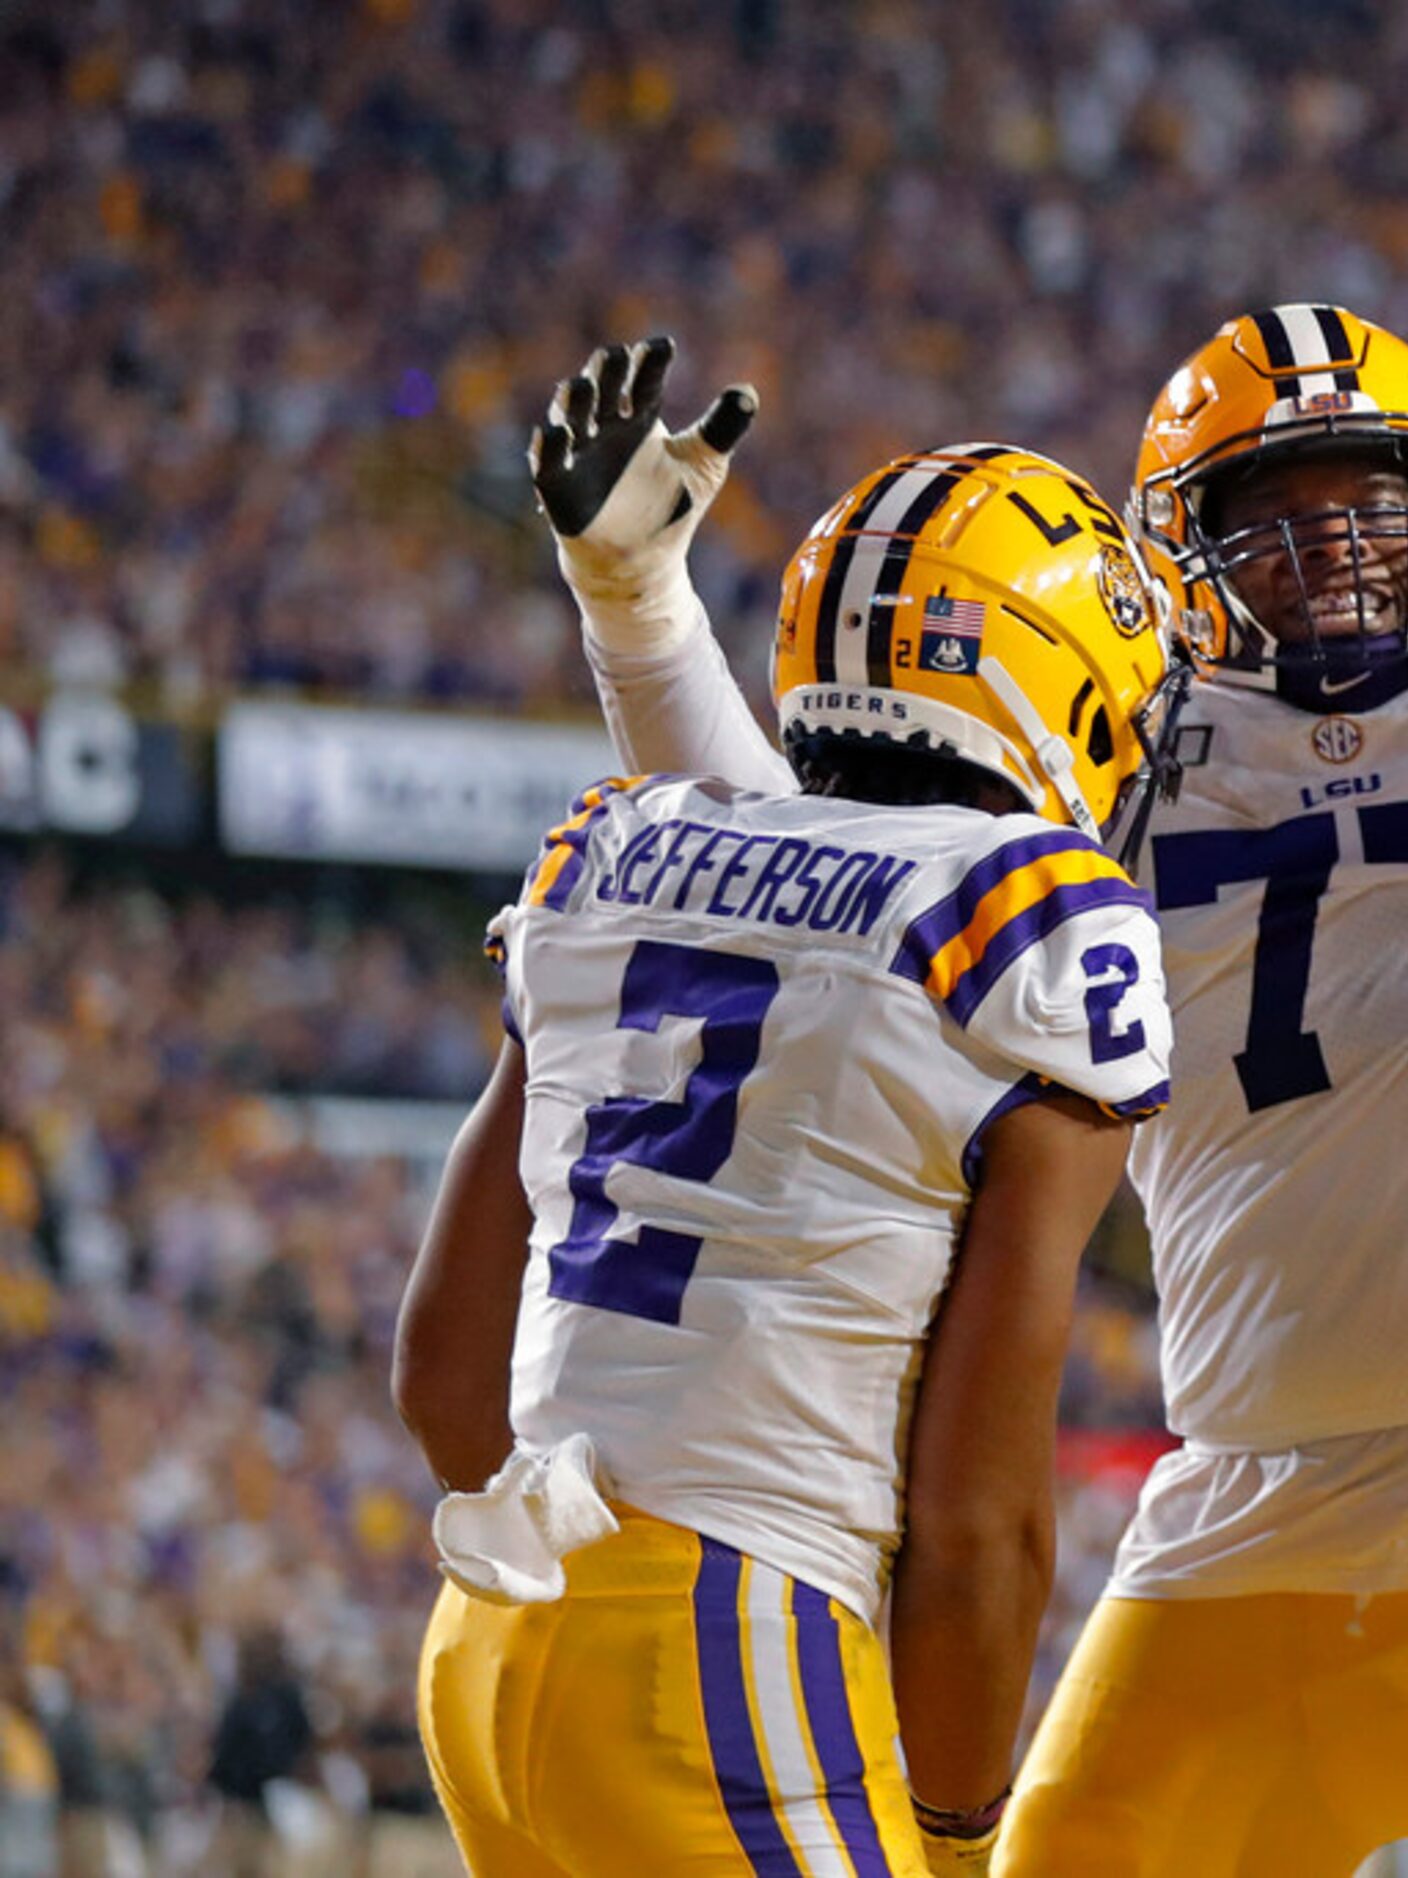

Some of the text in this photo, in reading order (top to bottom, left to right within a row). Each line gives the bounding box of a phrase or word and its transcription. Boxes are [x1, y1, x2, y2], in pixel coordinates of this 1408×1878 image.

[1292, 392, 1354, 416] LSU
[896, 640, 911, 668] 2
[801, 693, 909, 720] TIGERS
[1315, 719, 1361, 761] SEC
[1301, 773, 1381, 808] LSU
[597, 819, 915, 935] JEFFERSON
[1080, 942, 1147, 1065] 2
[548, 940, 780, 1325] 2
